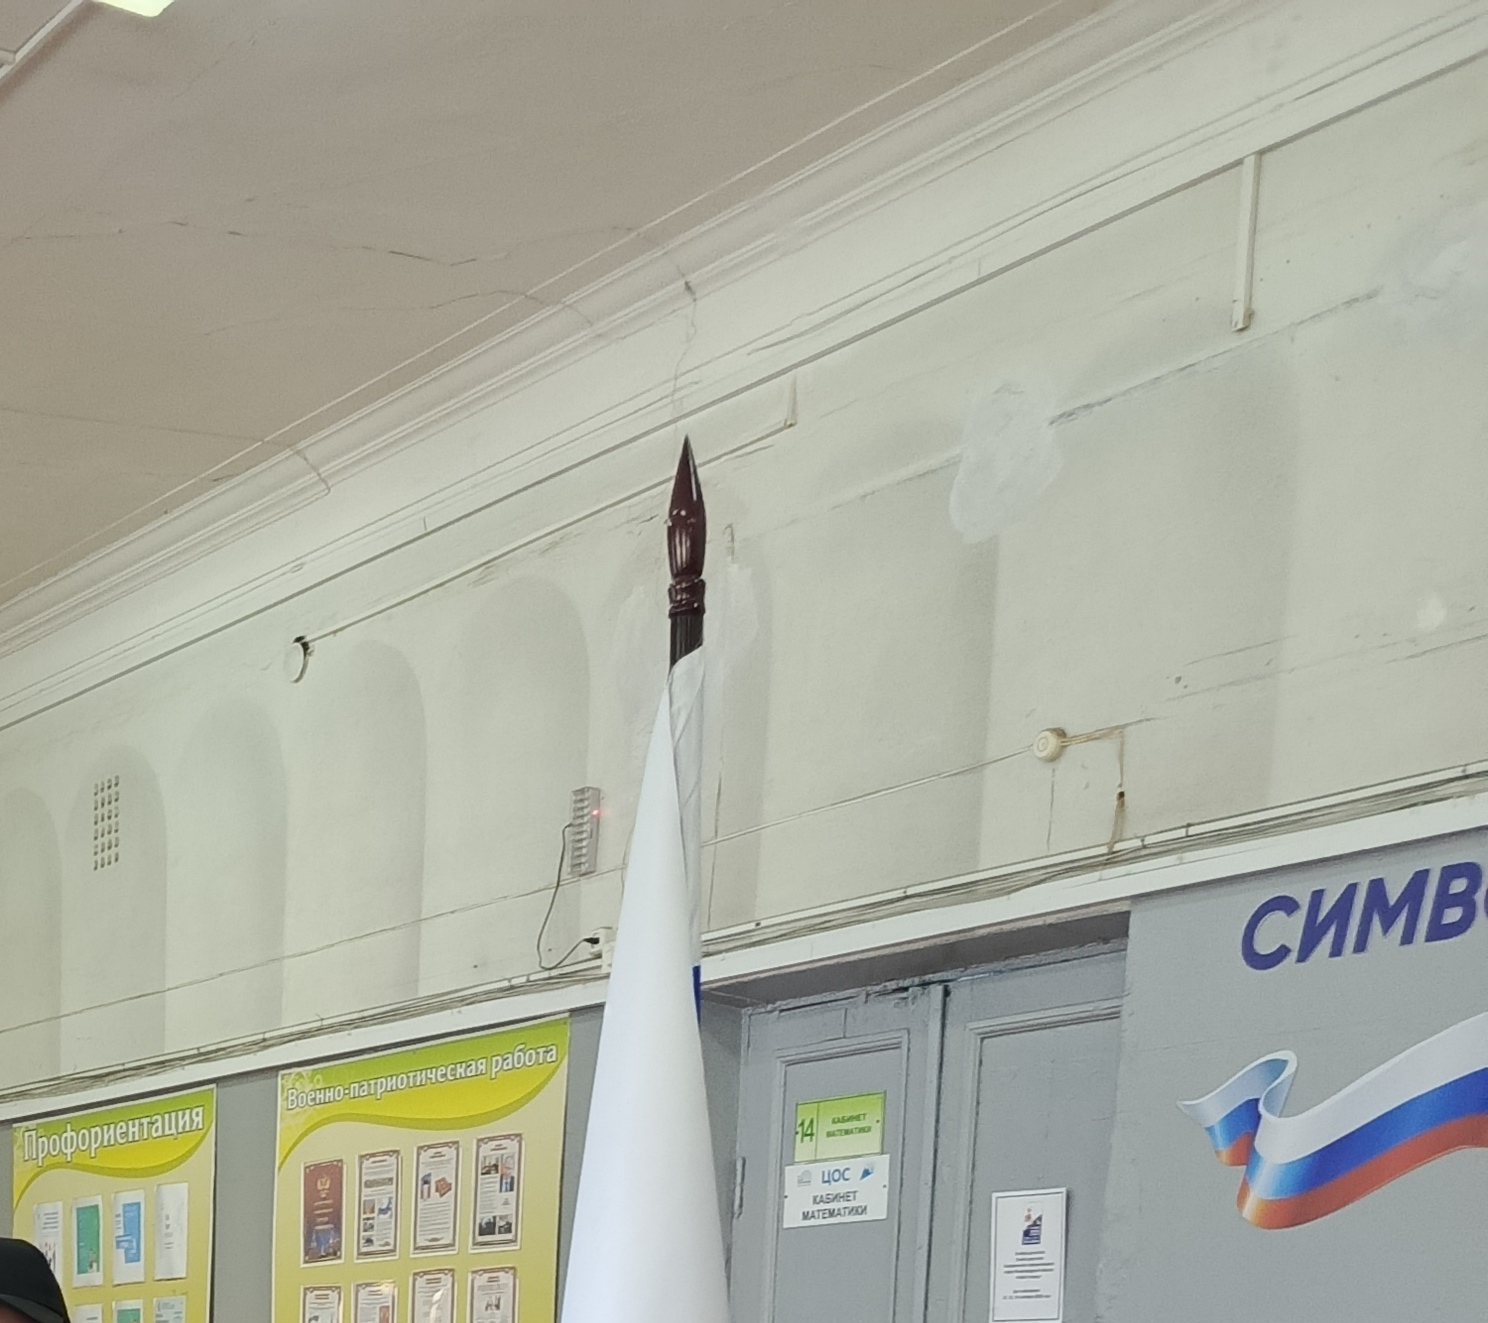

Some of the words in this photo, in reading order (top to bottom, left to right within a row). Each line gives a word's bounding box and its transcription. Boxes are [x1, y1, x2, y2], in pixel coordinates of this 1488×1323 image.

[1241, 861, 1488, 971] СИМВ
[286, 1057, 488, 1110] Военно-патриотическая
[490, 1043, 559, 1079] работа
[23, 1105, 206, 1168] Профориентация
[798, 1118, 814, 1143] 14
[821, 1168, 850, 1185] ЦОС
[812, 1191, 858, 1205] КАБИНЕТ
[801, 1205, 867, 1221] МАТЕМАТИКИ
